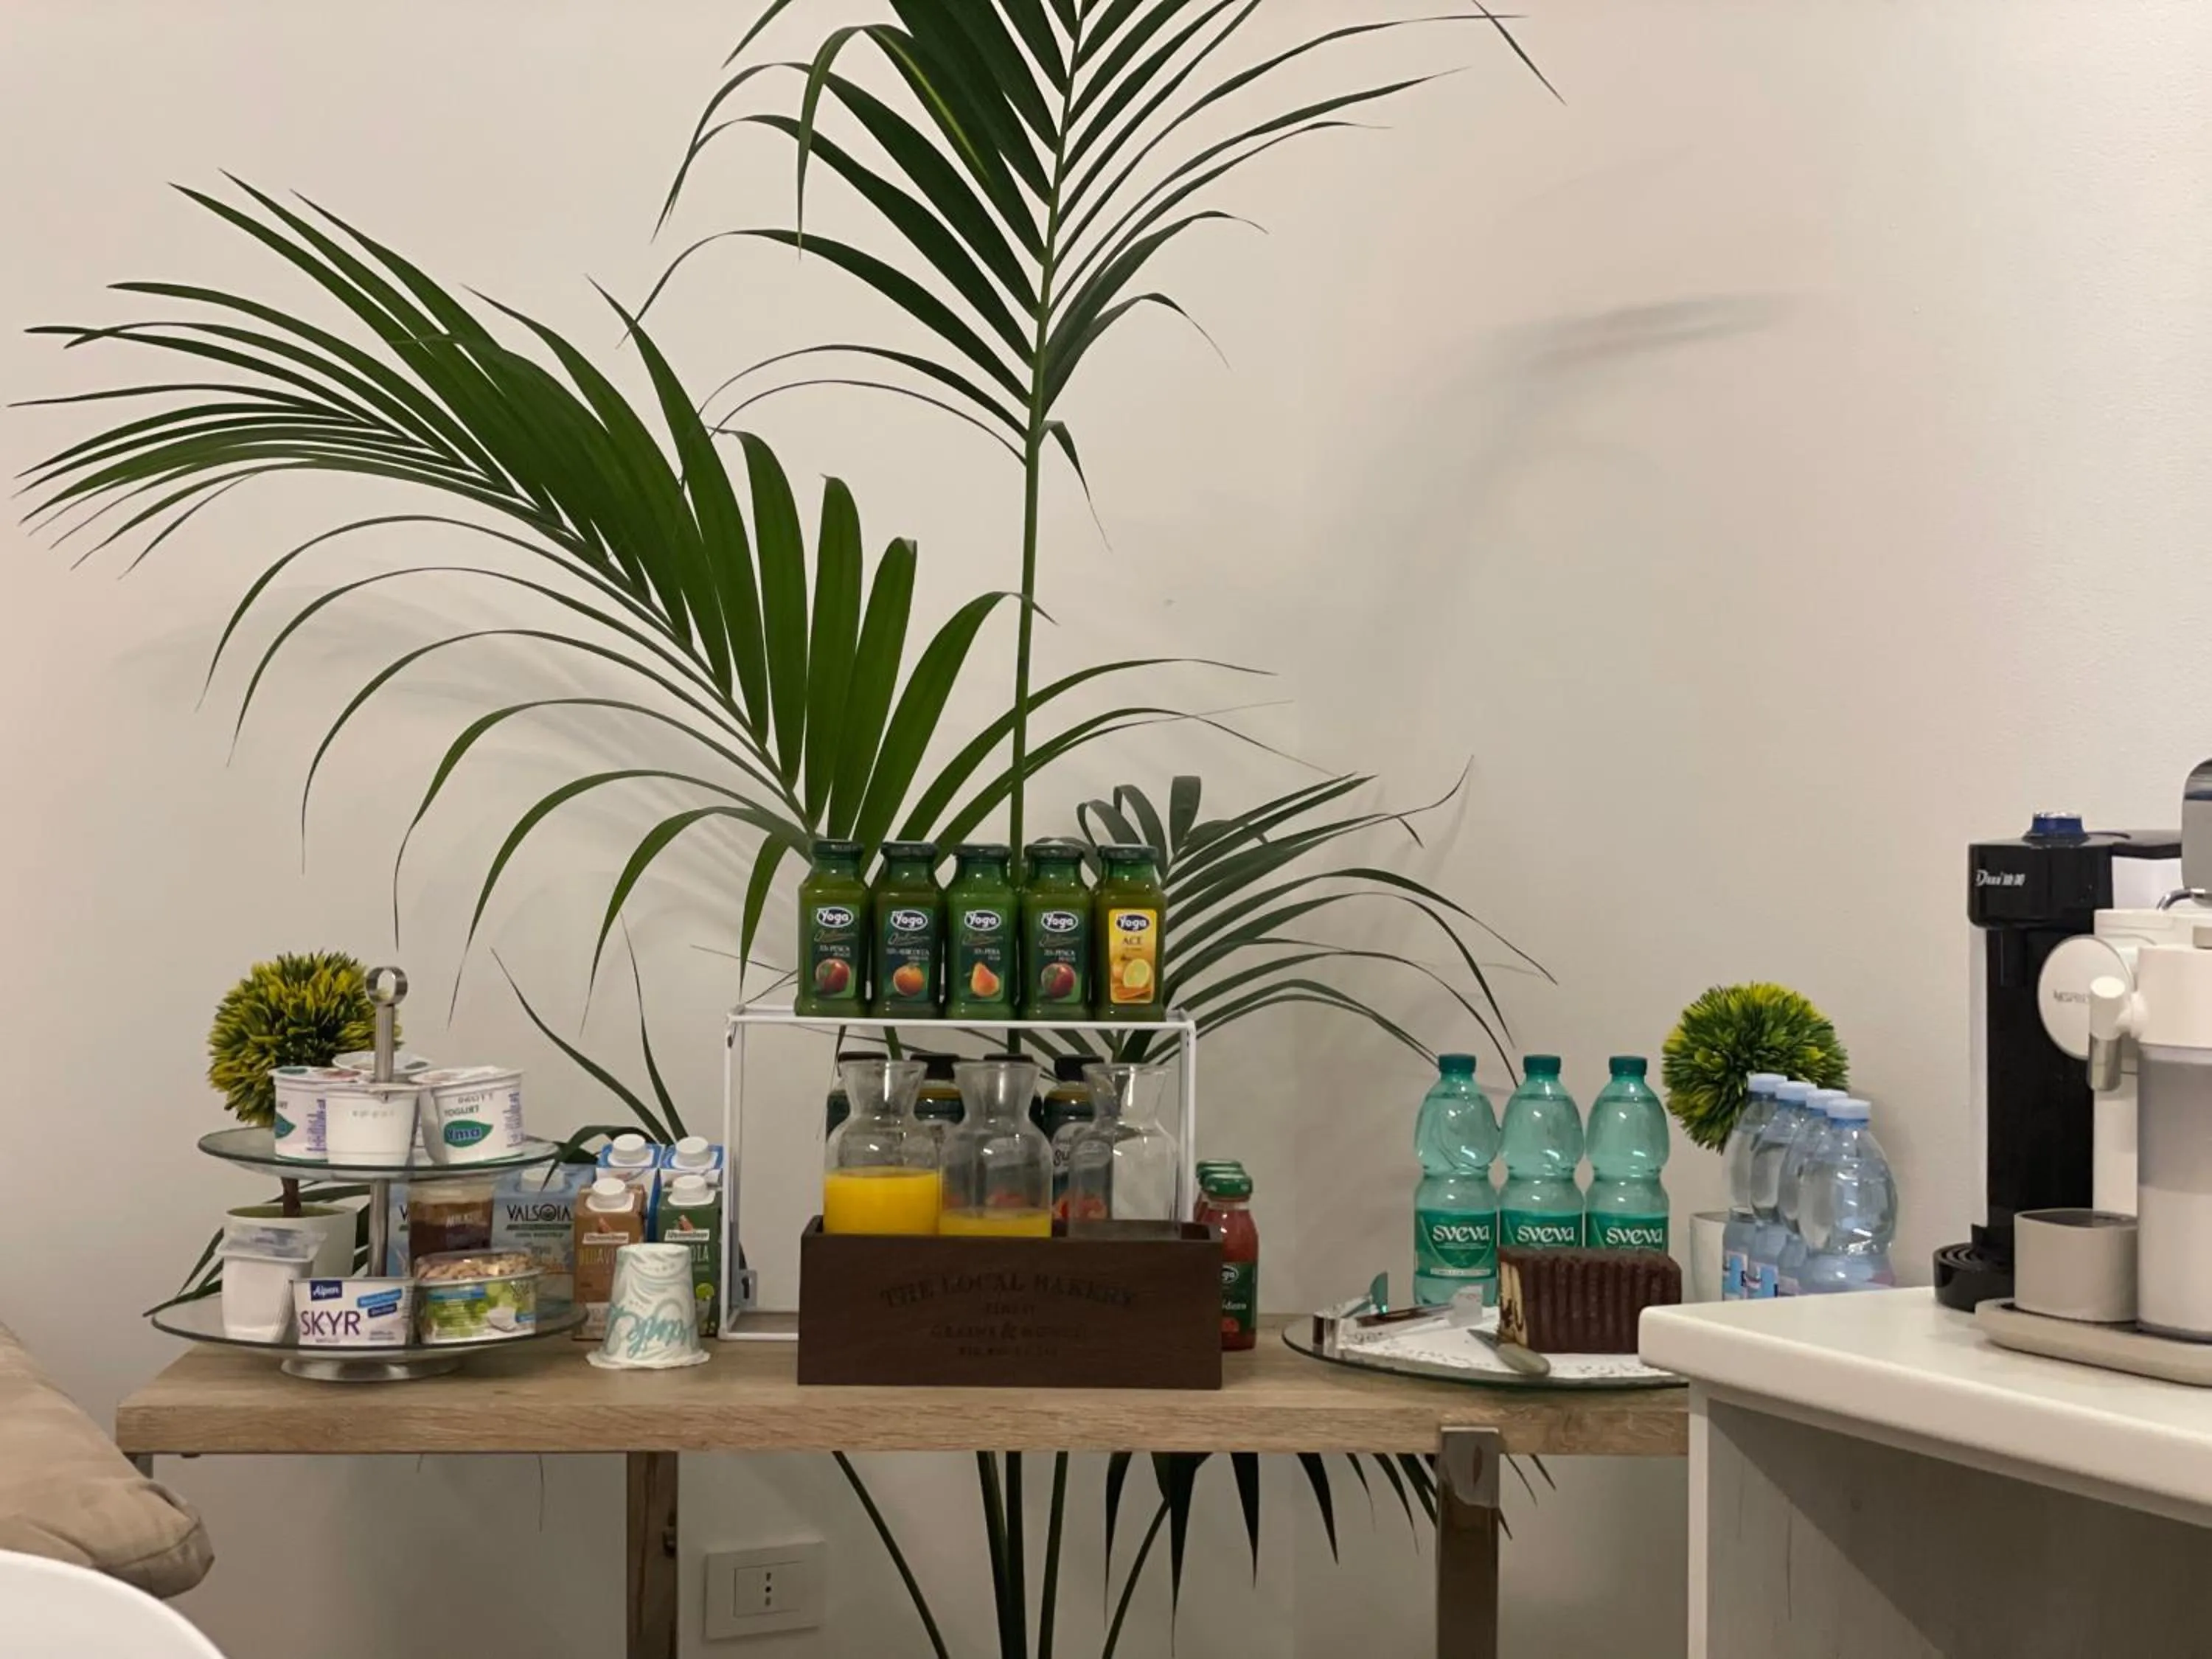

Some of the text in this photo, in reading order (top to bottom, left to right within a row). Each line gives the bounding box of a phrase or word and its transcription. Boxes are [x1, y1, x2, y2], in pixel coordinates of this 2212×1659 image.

[821, 910, 849, 925] Yoga
[895, 911, 923, 928] Yoga
[970, 912, 996, 927] Yoga
[1046, 913, 1074, 928] Yoga
[1120, 916, 1147, 930] Yoga
[507, 1203, 574, 1222] VALSOIA
[942, 1272, 1026, 1295] LOCAL
[300, 1310, 361, 1337] SKYR
